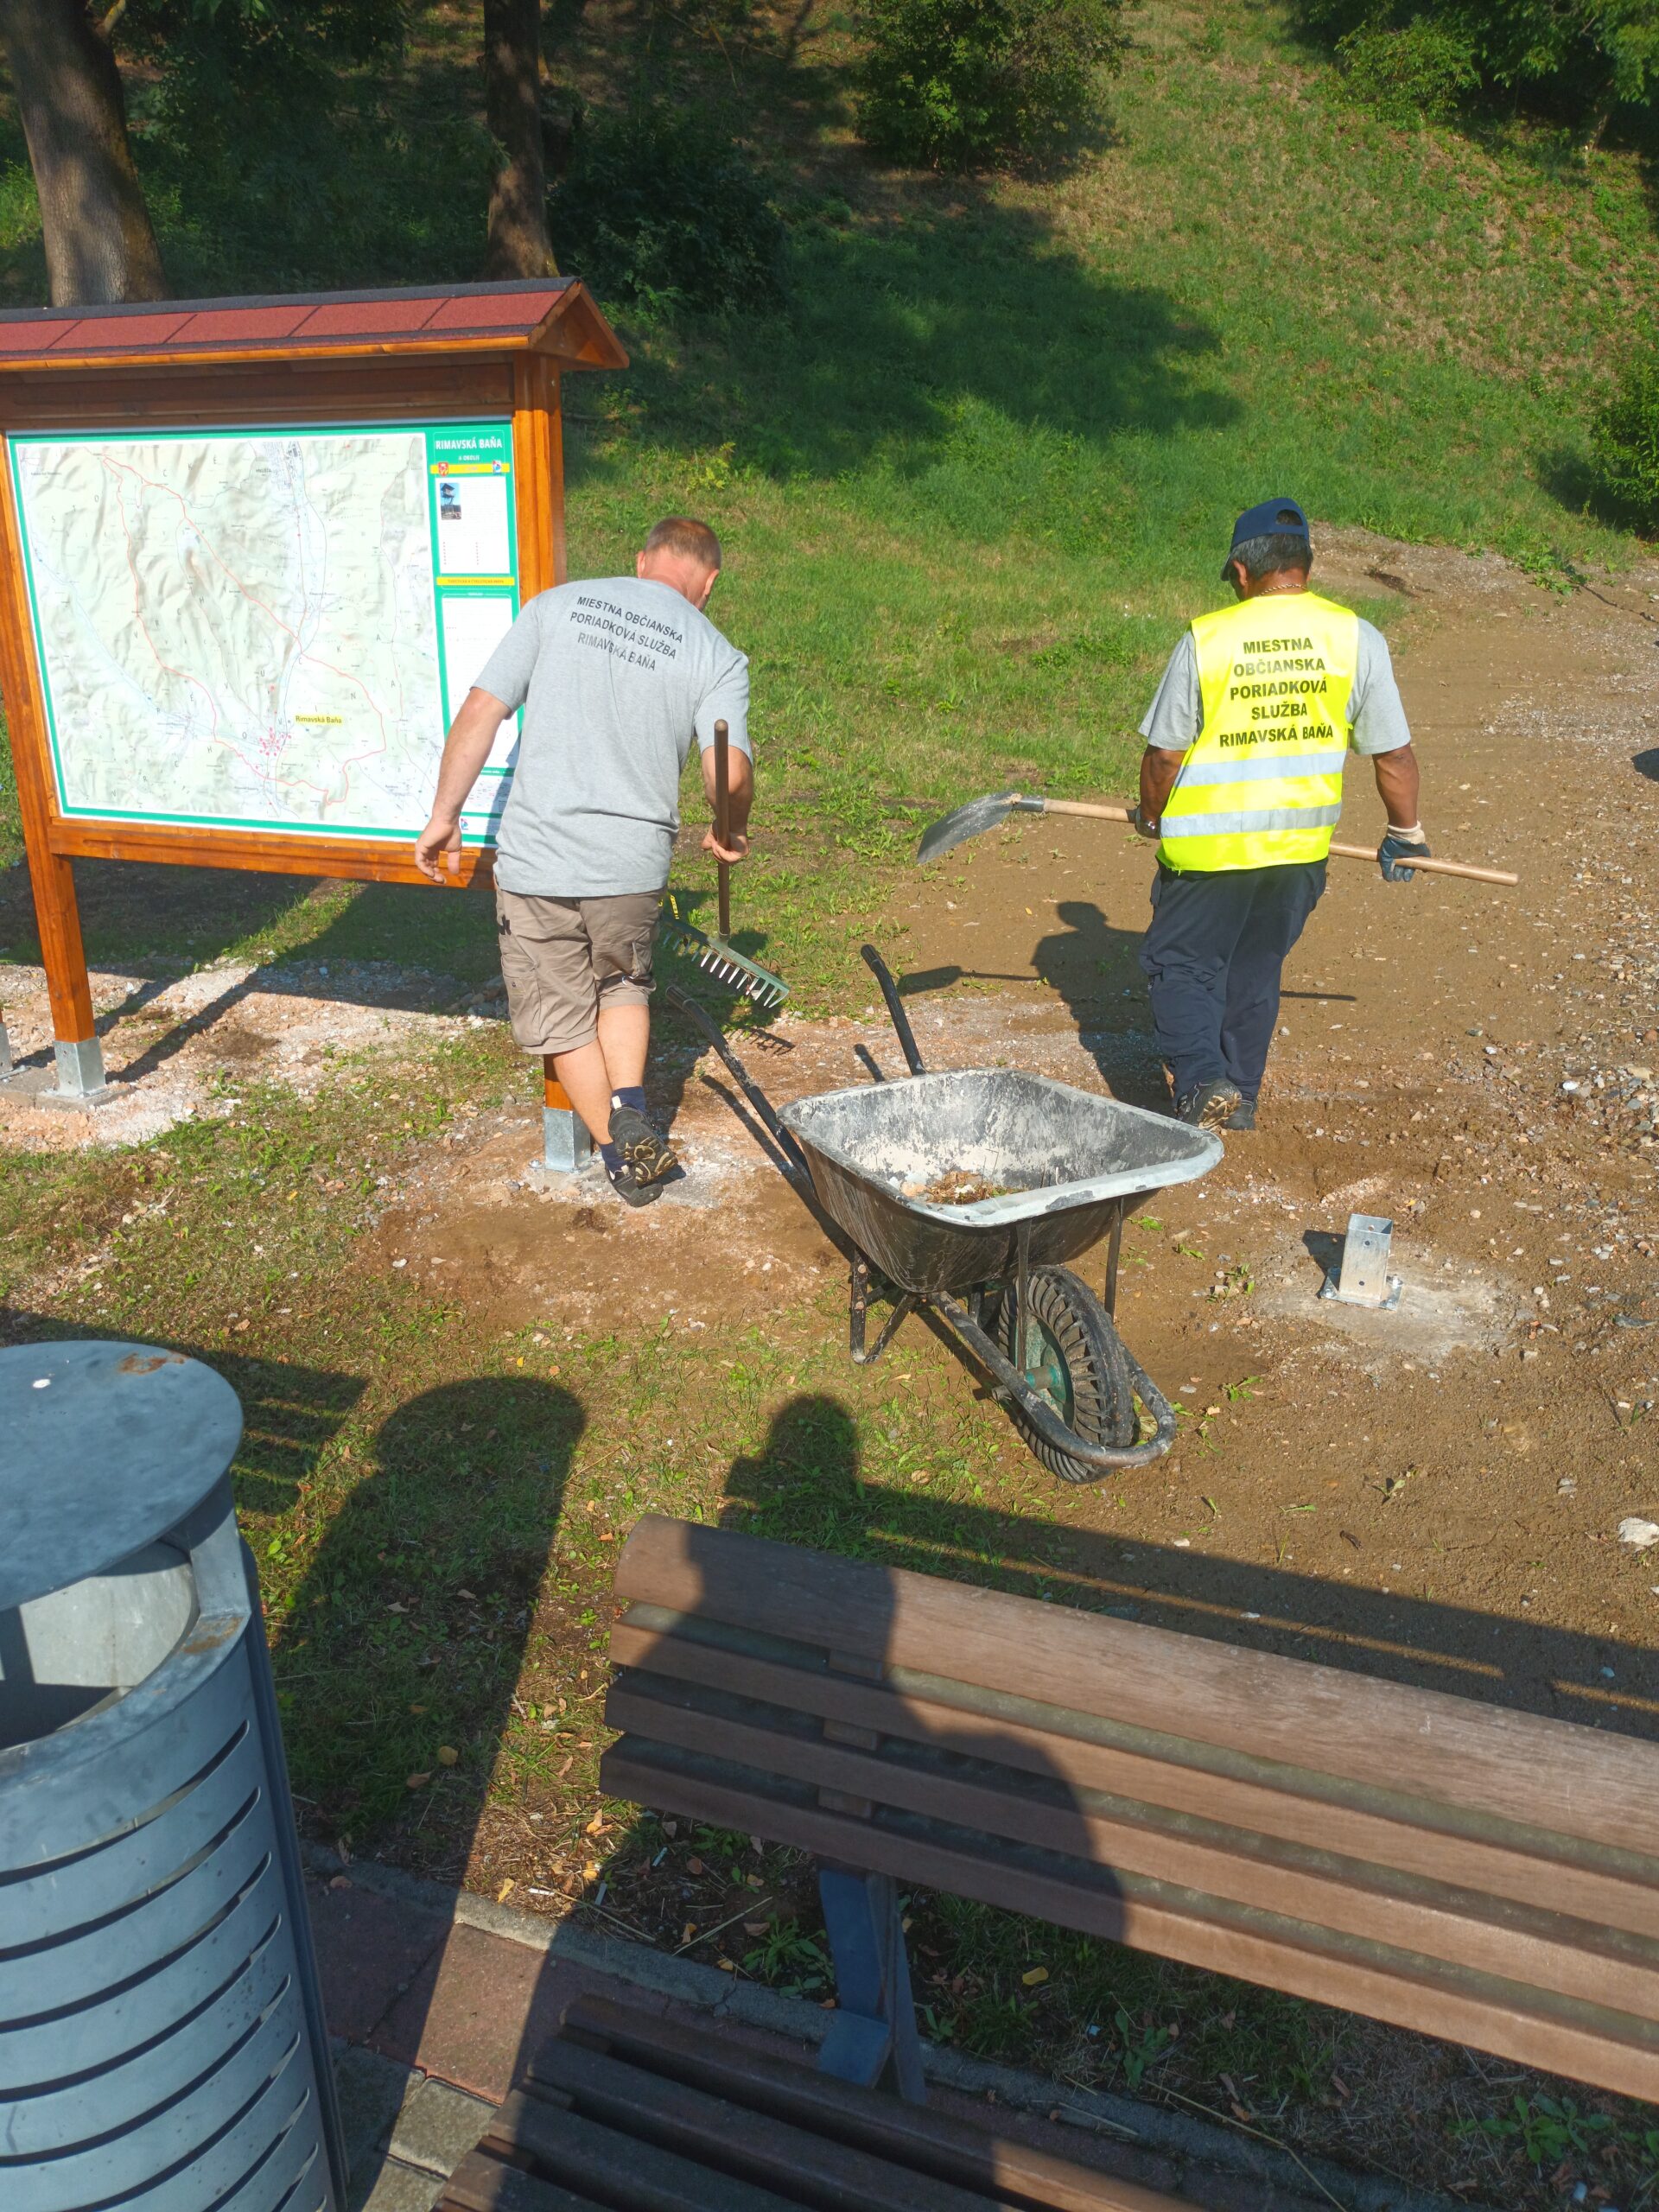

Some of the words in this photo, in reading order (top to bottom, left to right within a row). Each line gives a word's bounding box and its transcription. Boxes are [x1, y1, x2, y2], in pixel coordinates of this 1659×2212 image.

[435, 436, 477, 449] RIMAVSKÁ
[479, 435, 503, 448] BAŇA
[576, 596, 622, 617] MIESTNA
[625, 611, 683, 643] OBČIANSKA
[569, 612, 638, 642] PORIADKOVÁ
[637, 635, 677, 659] SLUŽBA
[577, 632, 627, 661] RIMAVSKÁ
[1243, 637, 1313, 654] MIESTNA
[1233, 658, 1325, 677] OBČIANSKA
[1230, 677, 1327, 701] PORIADKOVÁ
[1251, 701, 1307, 721] SLUŽBA
[1219, 723, 1298, 748] RIMAVSKÁ
[1302, 722, 1333, 740] BAŇA
